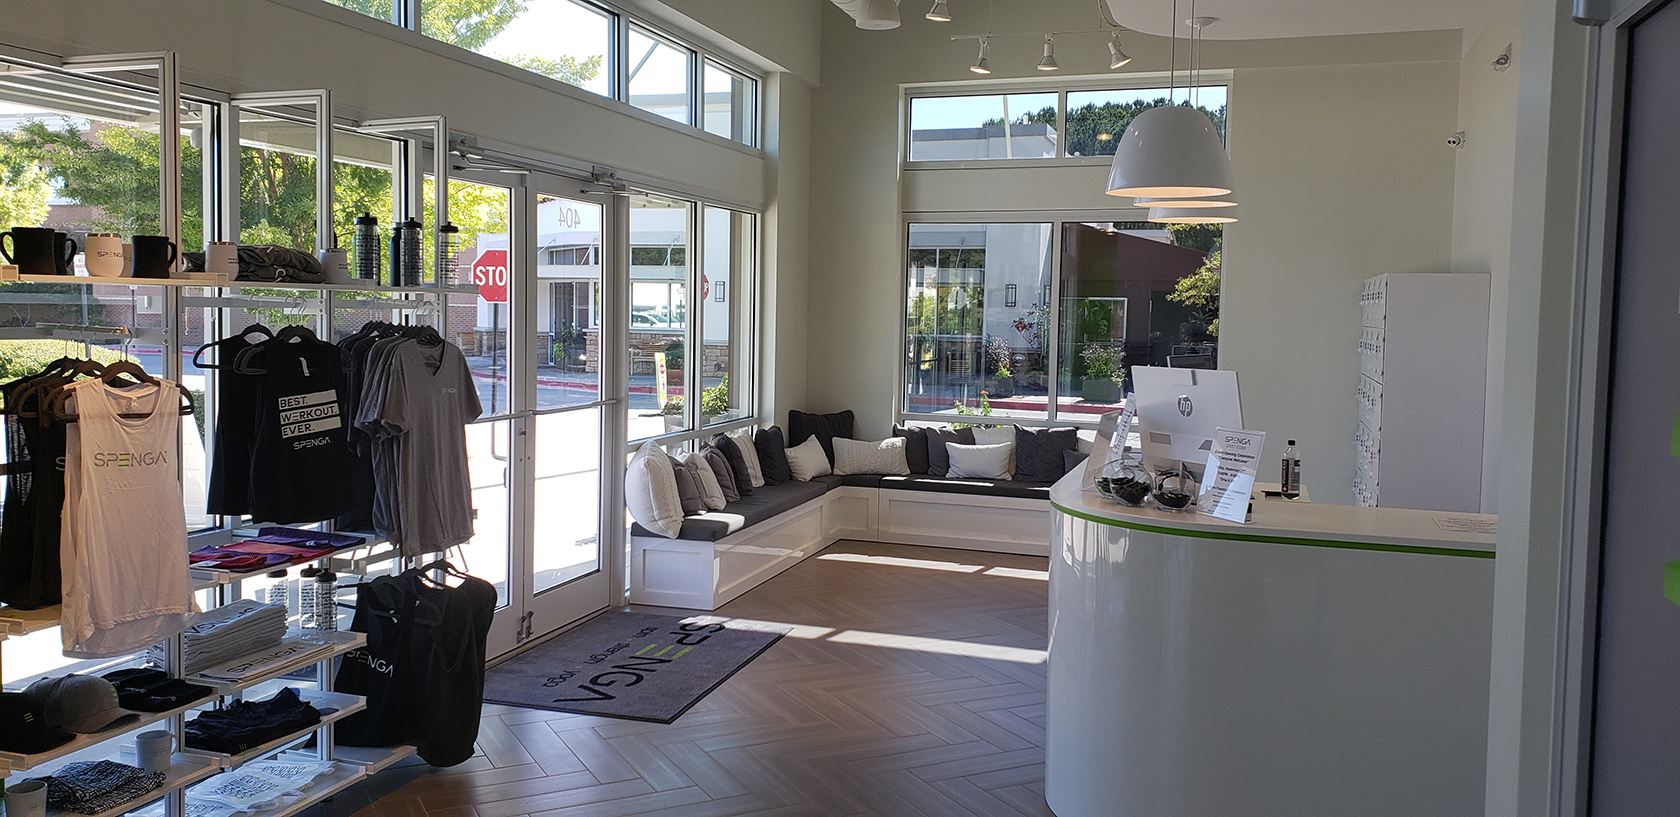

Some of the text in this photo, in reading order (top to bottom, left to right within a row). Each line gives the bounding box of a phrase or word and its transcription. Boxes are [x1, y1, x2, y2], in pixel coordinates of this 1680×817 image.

[97, 250, 124, 258] SPENG
[475, 266, 507, 286] STO
[280, 396, 308, 408] BEST.
[1180, 398, 1191, 416] hp
[281, 405, 338, 422] WERKOUT.
[283, 423, 315, 436] EVER.
[293, 436, 331, 450] SPENGA
[1224, 435, 1251, 446] SPENGA
[94, 451, 168, 467] SPENGA
[541, 626, 658, 689] spin strength yoga
[552, 620, 725, 703] SPENGA
